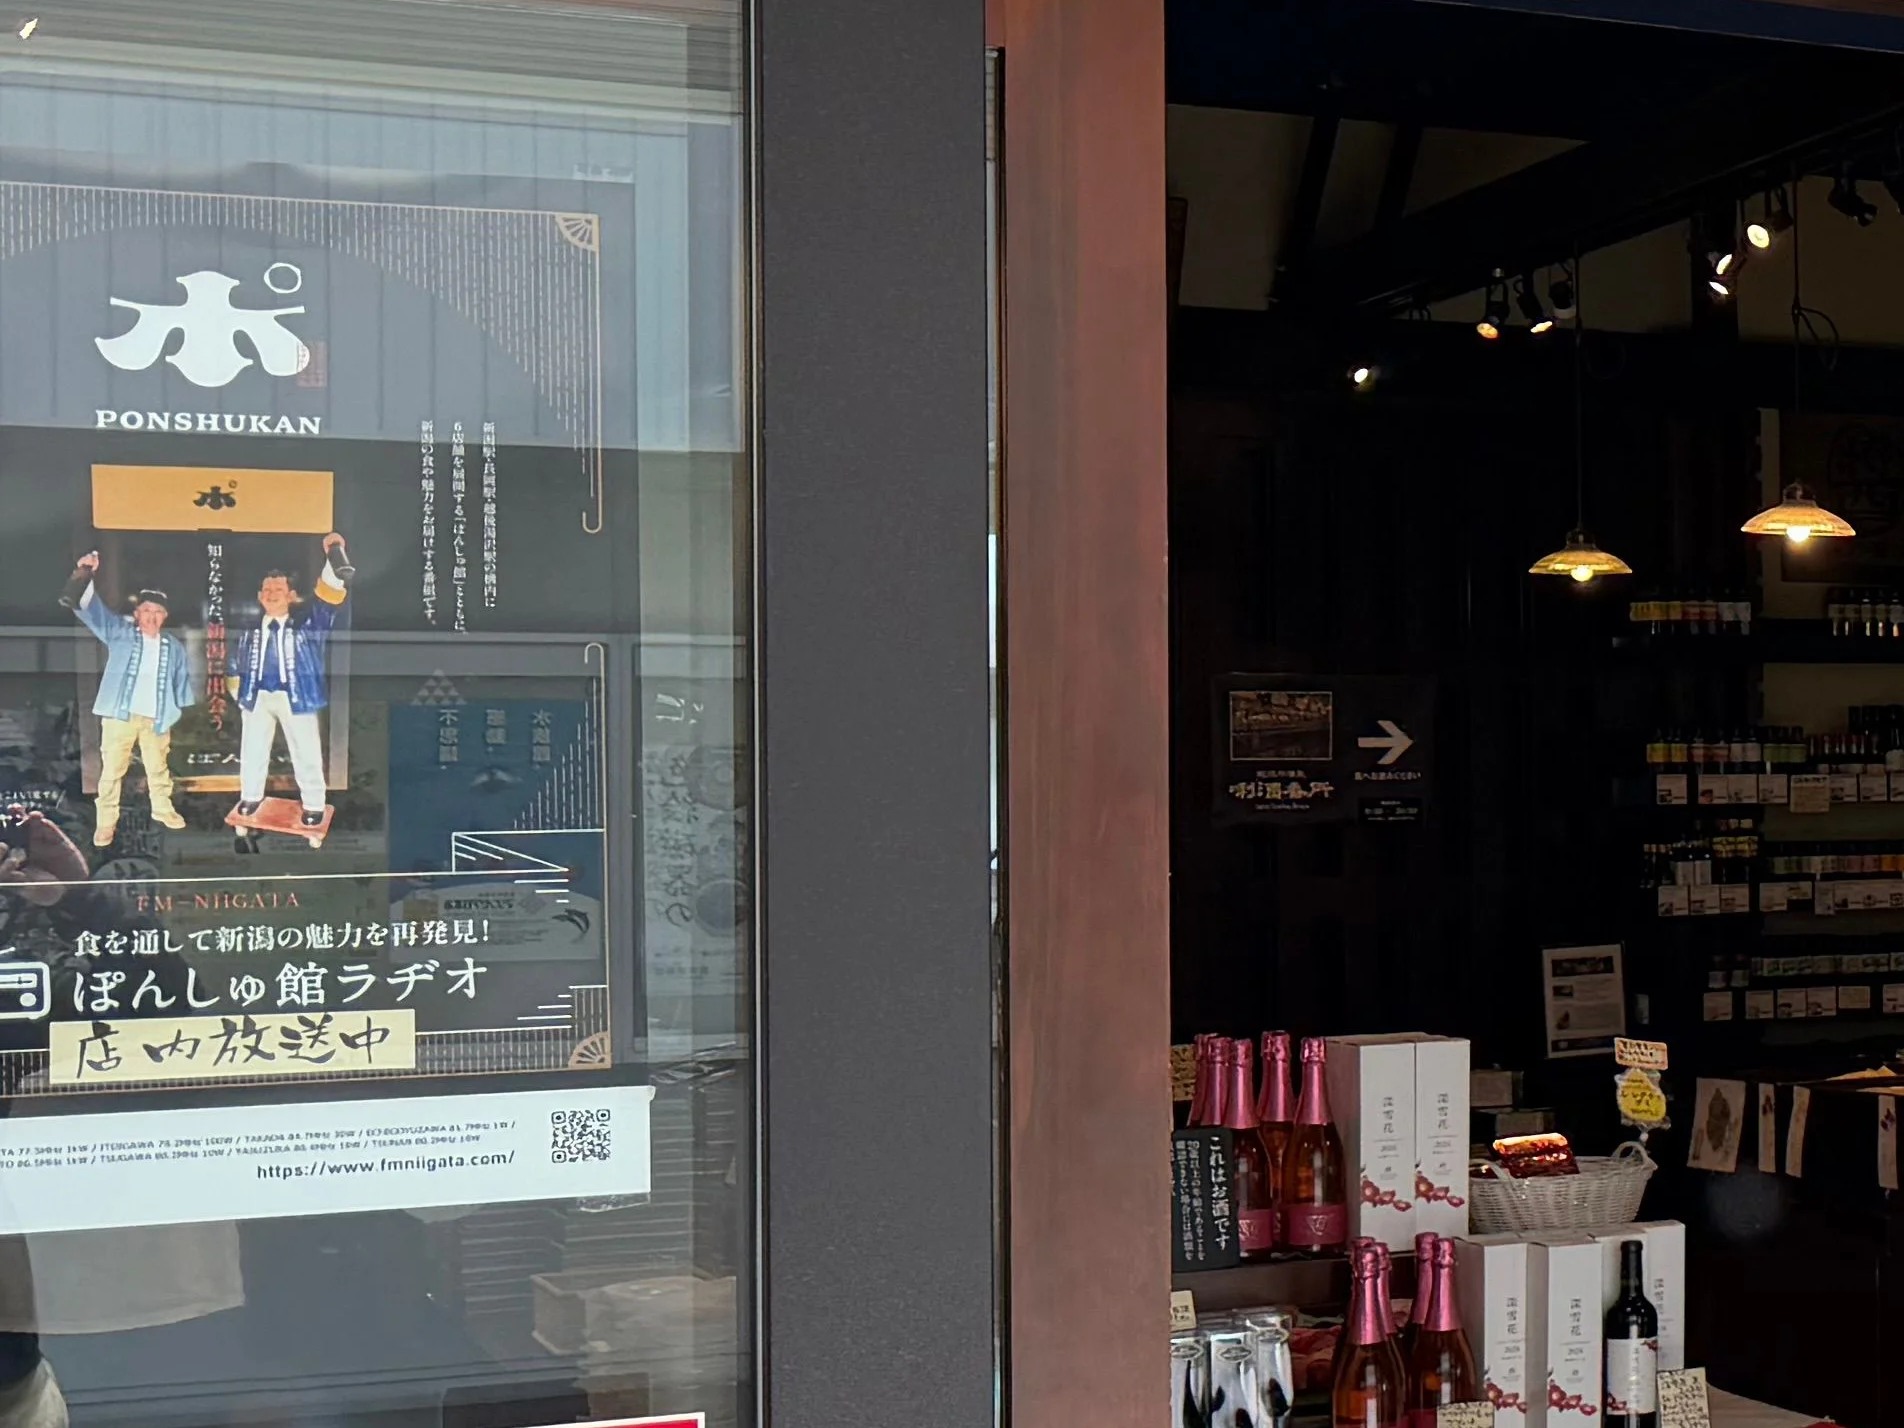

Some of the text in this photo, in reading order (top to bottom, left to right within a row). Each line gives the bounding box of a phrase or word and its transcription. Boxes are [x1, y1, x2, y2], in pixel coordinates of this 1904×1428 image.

[95, 409, 322, 436] PONSHUKAN
[74, 920, 490, 958] 食を通して新潟の魅力を再発見!
[72, 957, 489, 1013] ぽんしゅ館ラヂオ
[75, 1010, 391, 1080] 店内放送中
[257, 1149, 516, 1180] https://www.fmniigata.com/
[1209, 1135, 1231, 1251] これはお酒です
